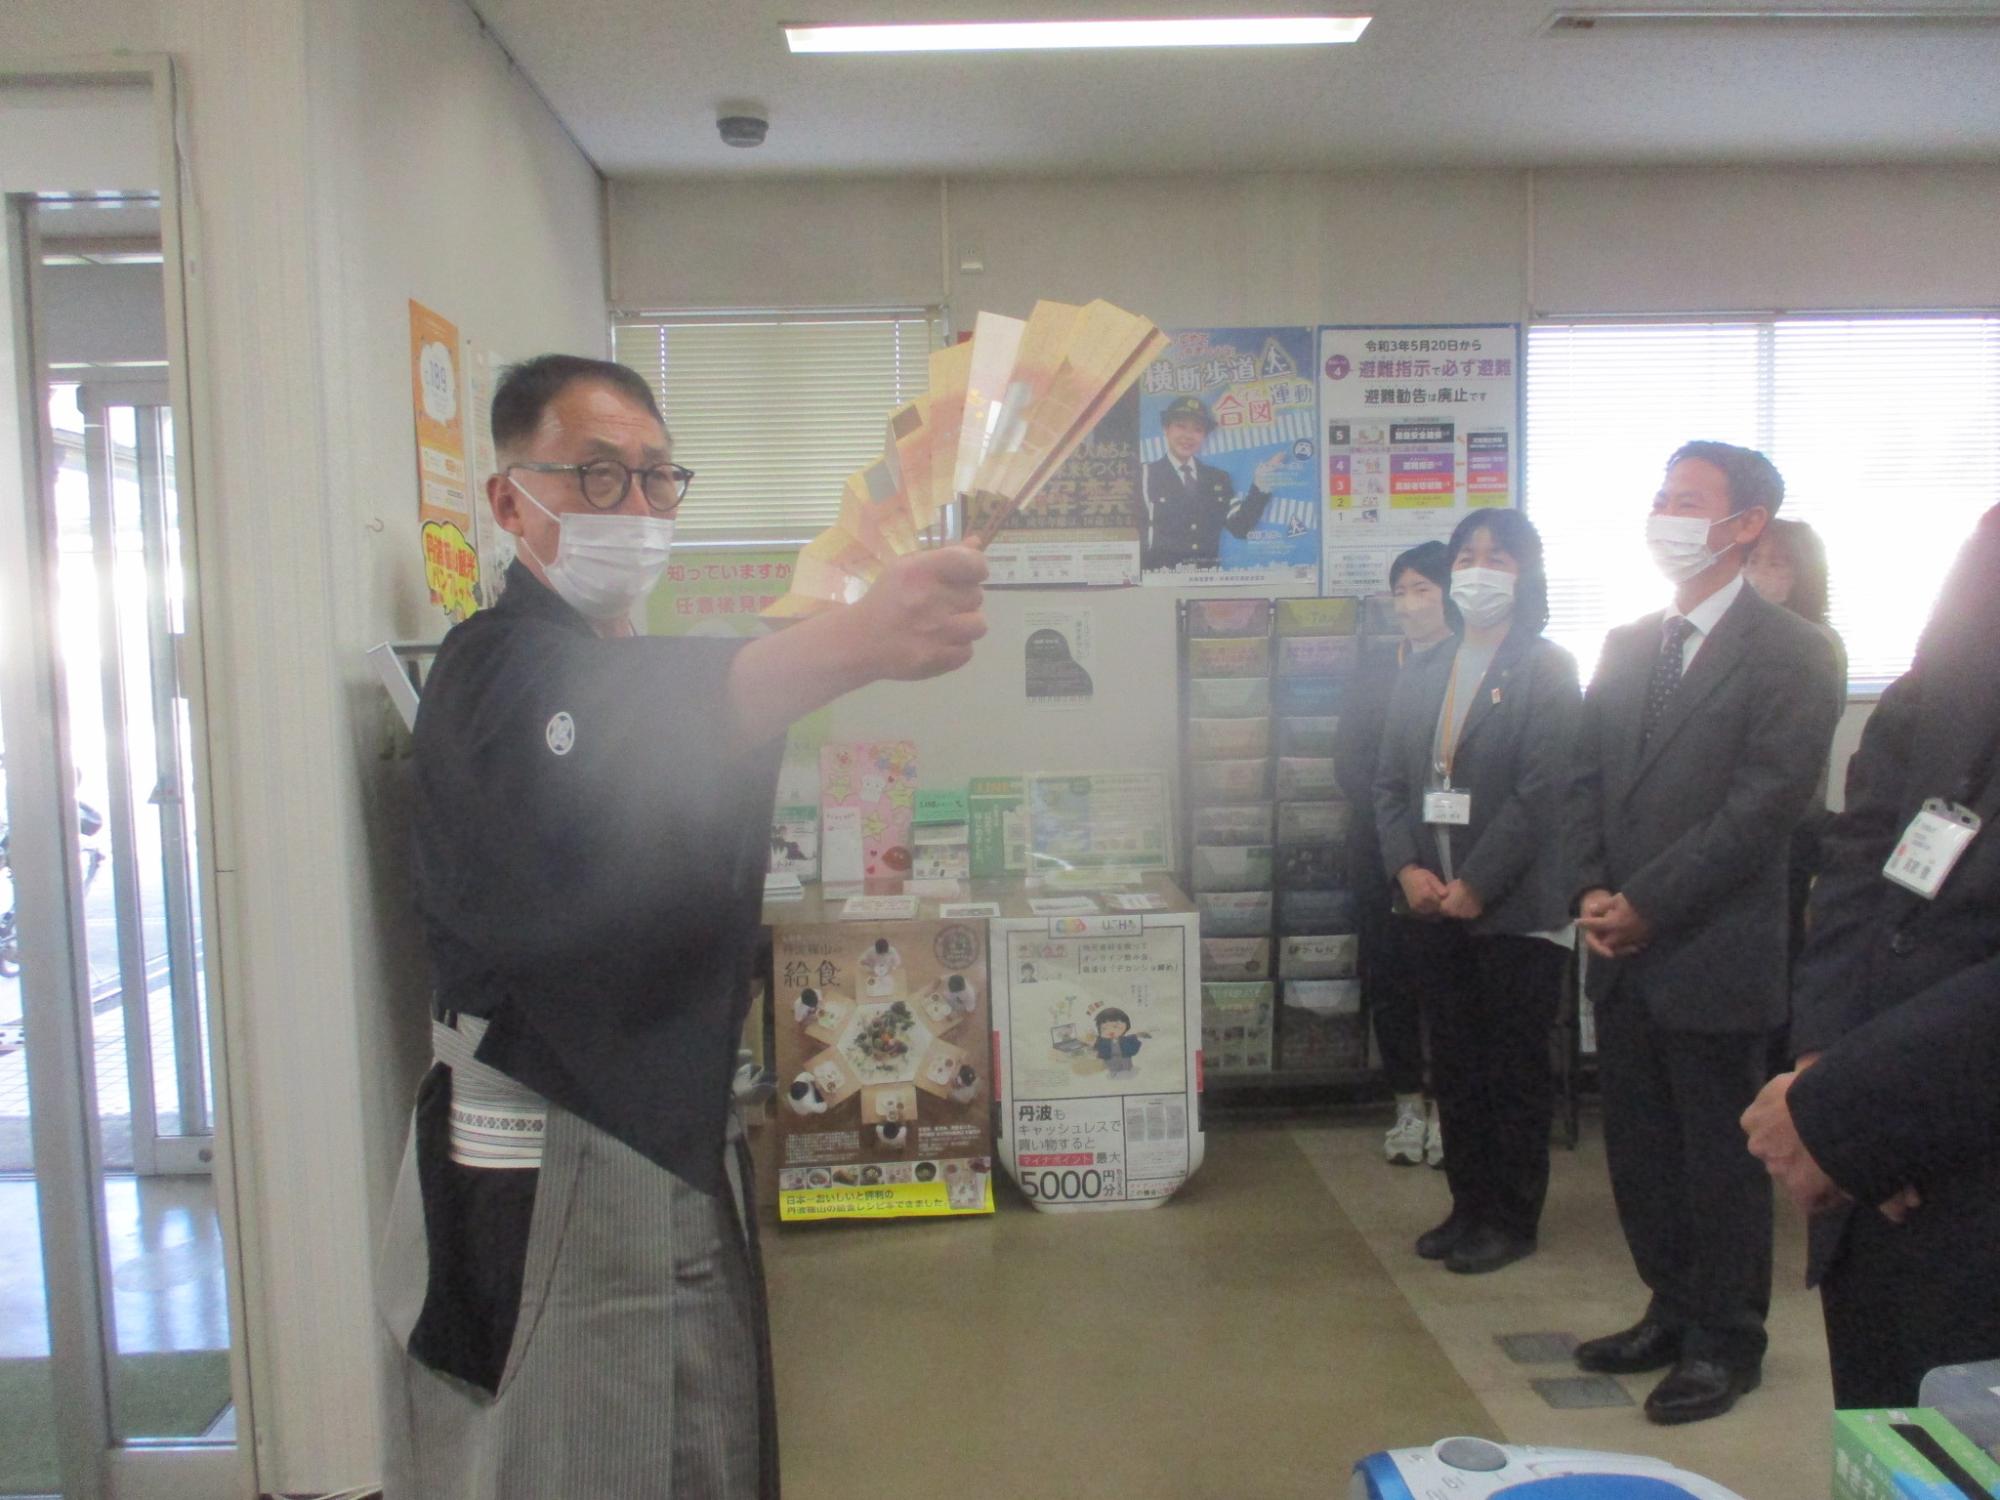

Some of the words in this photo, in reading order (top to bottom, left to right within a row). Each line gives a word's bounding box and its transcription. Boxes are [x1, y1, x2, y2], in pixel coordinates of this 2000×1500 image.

[1365, 339, 1482, 352] 令和3年5月20日から
[1145, 357, 1258, 393] 横断歩道
[1359, 359, 1511, 378] 避難指示で必ず避難
[1364, 388, 1487, 404] 避難勧告は廃止です
[1215, 395, 1272, 426] 合図
[1336, 430, 1344, 441] 5
[1336, 461, 1345, 471] 4
[1336, 480, 1344, 491] 3
[1337, 497, 1345, 508] 2
[667, 563, 791, 582] 知っていますか
[784, 960, 842, 987] 給食
[1019, 1105, 1066, 1121] 丹波も
[1018, 1120, 1122, 1136] キャッシュレスで
[1018, 1137, 1096, 1150] 買い物すると
[1021, 1154, 1093, 1165] マイナポイント
[1096, 1151, 1122, 1164] 最大
[1020, 1169, 1101, 1200] 5000
